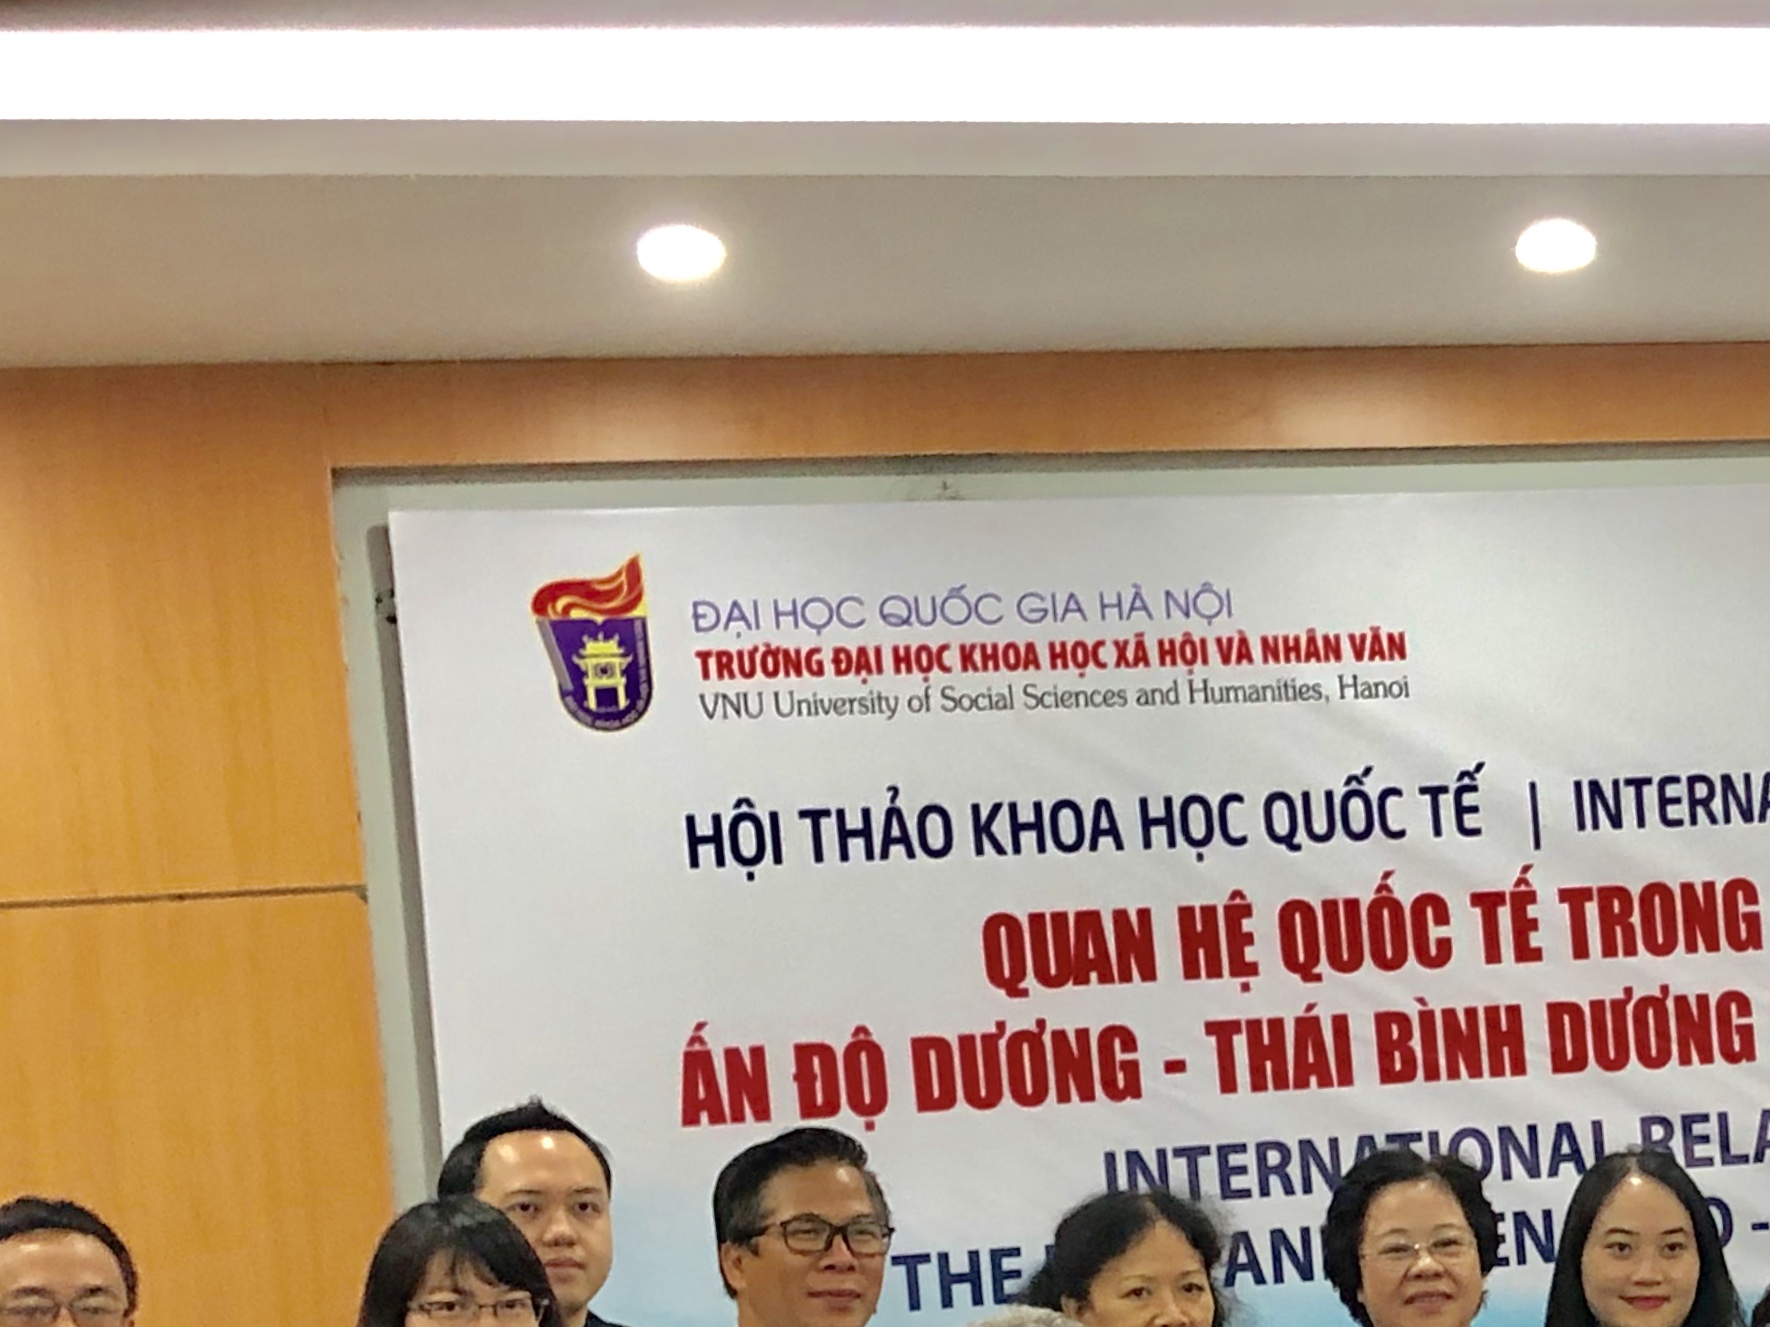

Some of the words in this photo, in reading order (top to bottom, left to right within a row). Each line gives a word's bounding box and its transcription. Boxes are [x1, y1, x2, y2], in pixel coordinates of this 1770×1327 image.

[692, 600, 760, 638] ĐẠI
[773, 596, 866, 636] HỌC
[879, 584, 1004, 627] QUỐC
[1016, 592, 1088, 624] GIA
[1099, 583, 1153, 621] HÀ
[1164, 582, 1233, 626] NỘI
[695, 643, 825, 680] TRƯỜNG
[831, 645, 883, 684] ĐẠI
[892, 643, 952, 682] HỌC
[959, 642, 1041, 672] KHOA
[1048, 640, 1108, 678] HỌC
[1113, 632, 1151, 668] XÃ
[1157, 632, 1209, 675] HỘI
[1215, 630, 1254, 666] VÀ
[1260, 628, 1342, 664] NHÂN
[1348, 626, 1406, 662] VĂN
[699, 692, 763, 720] VNU
[773, 690, 899, 720] University
[907, 685, 931, 713] of
[941, 684, 1014, 712] Social
[1023, 683, 1128, 710] Sciences
[1136, 679, 1180, 706] and
[1187, 677, 1331, 708] Humanities,
[1338, 674, 1410, 700] Hanoi
[686, 798, 782, 881] HỘI
[798, 786, 953, 863] THẢO
[971, 798, 1124, 856] KHOA
[1139, 793, 1247, 862] HỌC
[1264, 766, 1406, 852] QUỐC
[1419, 762, 1485, 837] TẾ
[983, 907, 1157, 998] QUAN
[1178, 890, 1259, 992] HỆ
[1278, 870, 1452, 983] QUỐC
[1470, 864, 1543, 965] TẾ
[1558, 878, 1763, 960] TRONG
[682, 1022, 771, 1127] ẤN
[793, 1026, 888, 1131] ĐỘ
[911, 1018, 1142, 1113] DƯƠNG
[1204, 1003, 1354, 1094] THÁI
[1374, 997, 1527, 1085] BÌNH
[1546, 984, 1756, 1074] DƯƠNG
[891, 1247, 1021, 1312] THE
[1224, 1226, 1328, 1287] AN
